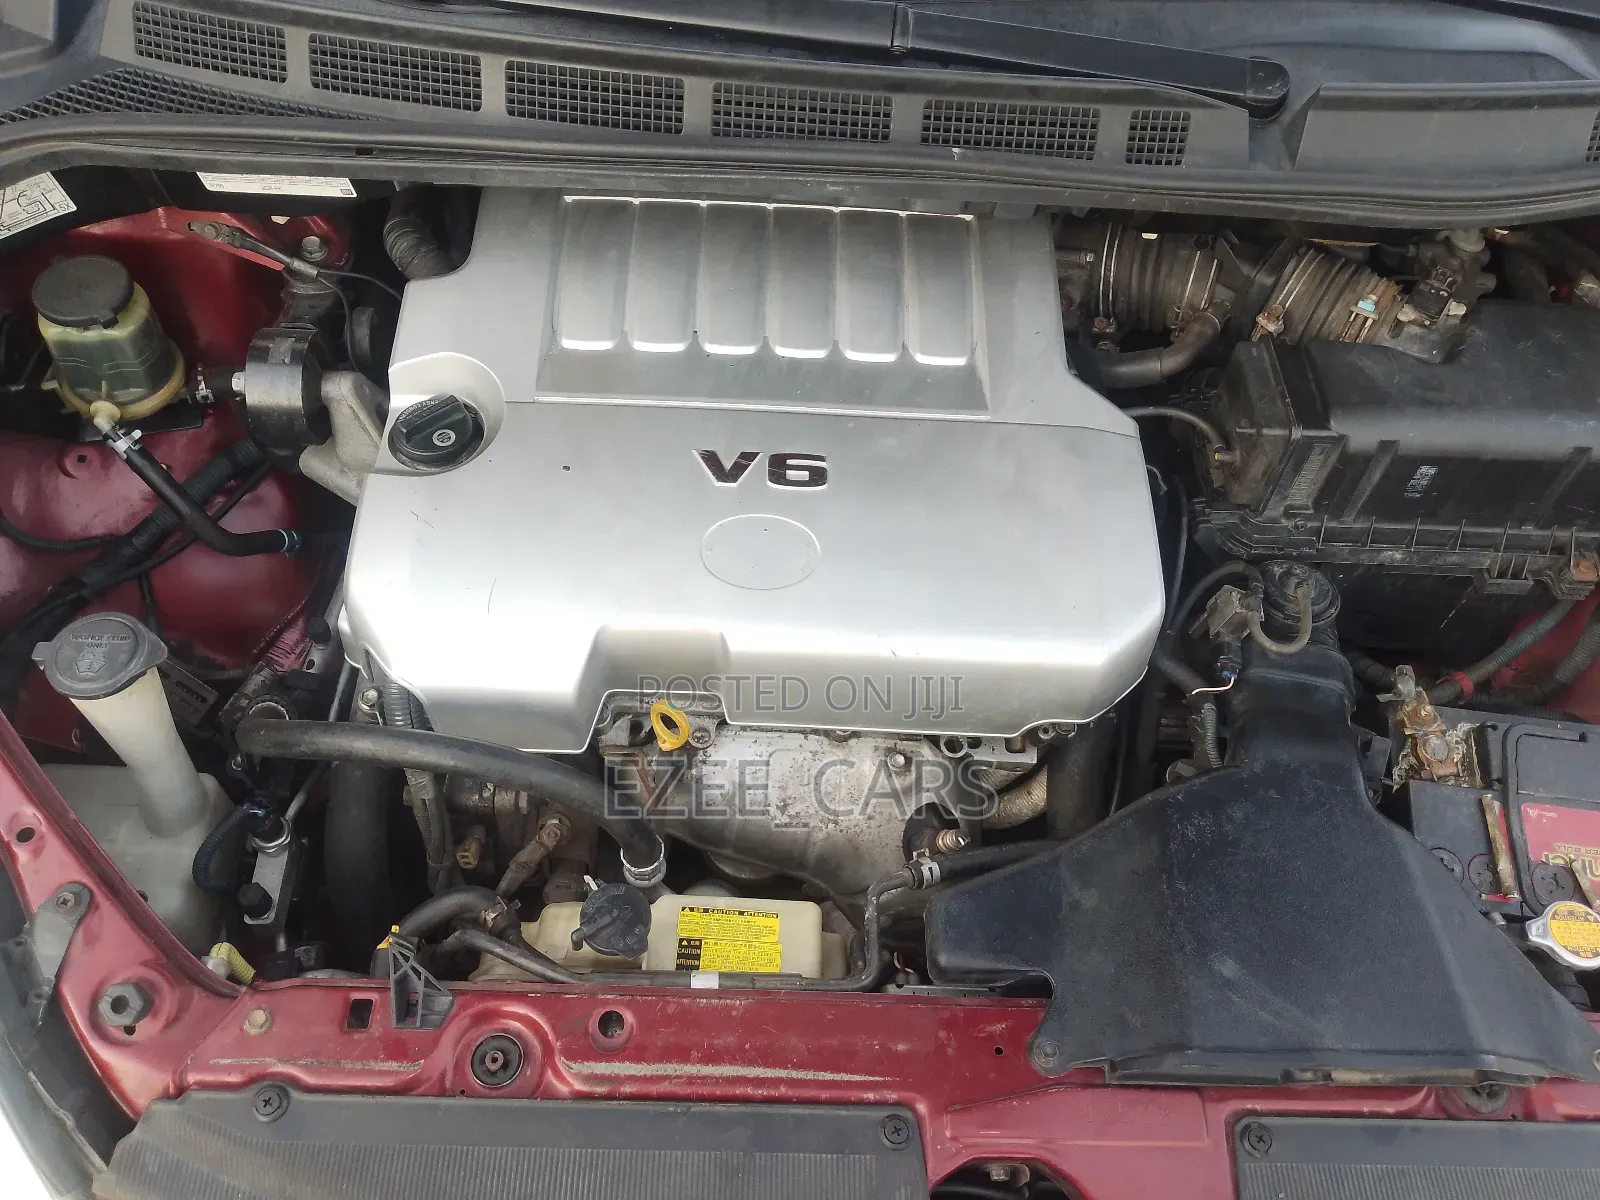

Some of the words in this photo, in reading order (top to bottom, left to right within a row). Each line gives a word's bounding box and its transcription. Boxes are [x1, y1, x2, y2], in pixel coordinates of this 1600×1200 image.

[692, 448, 828, 490] V6
[677, 947, 701, 955] CAUTION
[676, 958, 700, 966] ATTENTION
